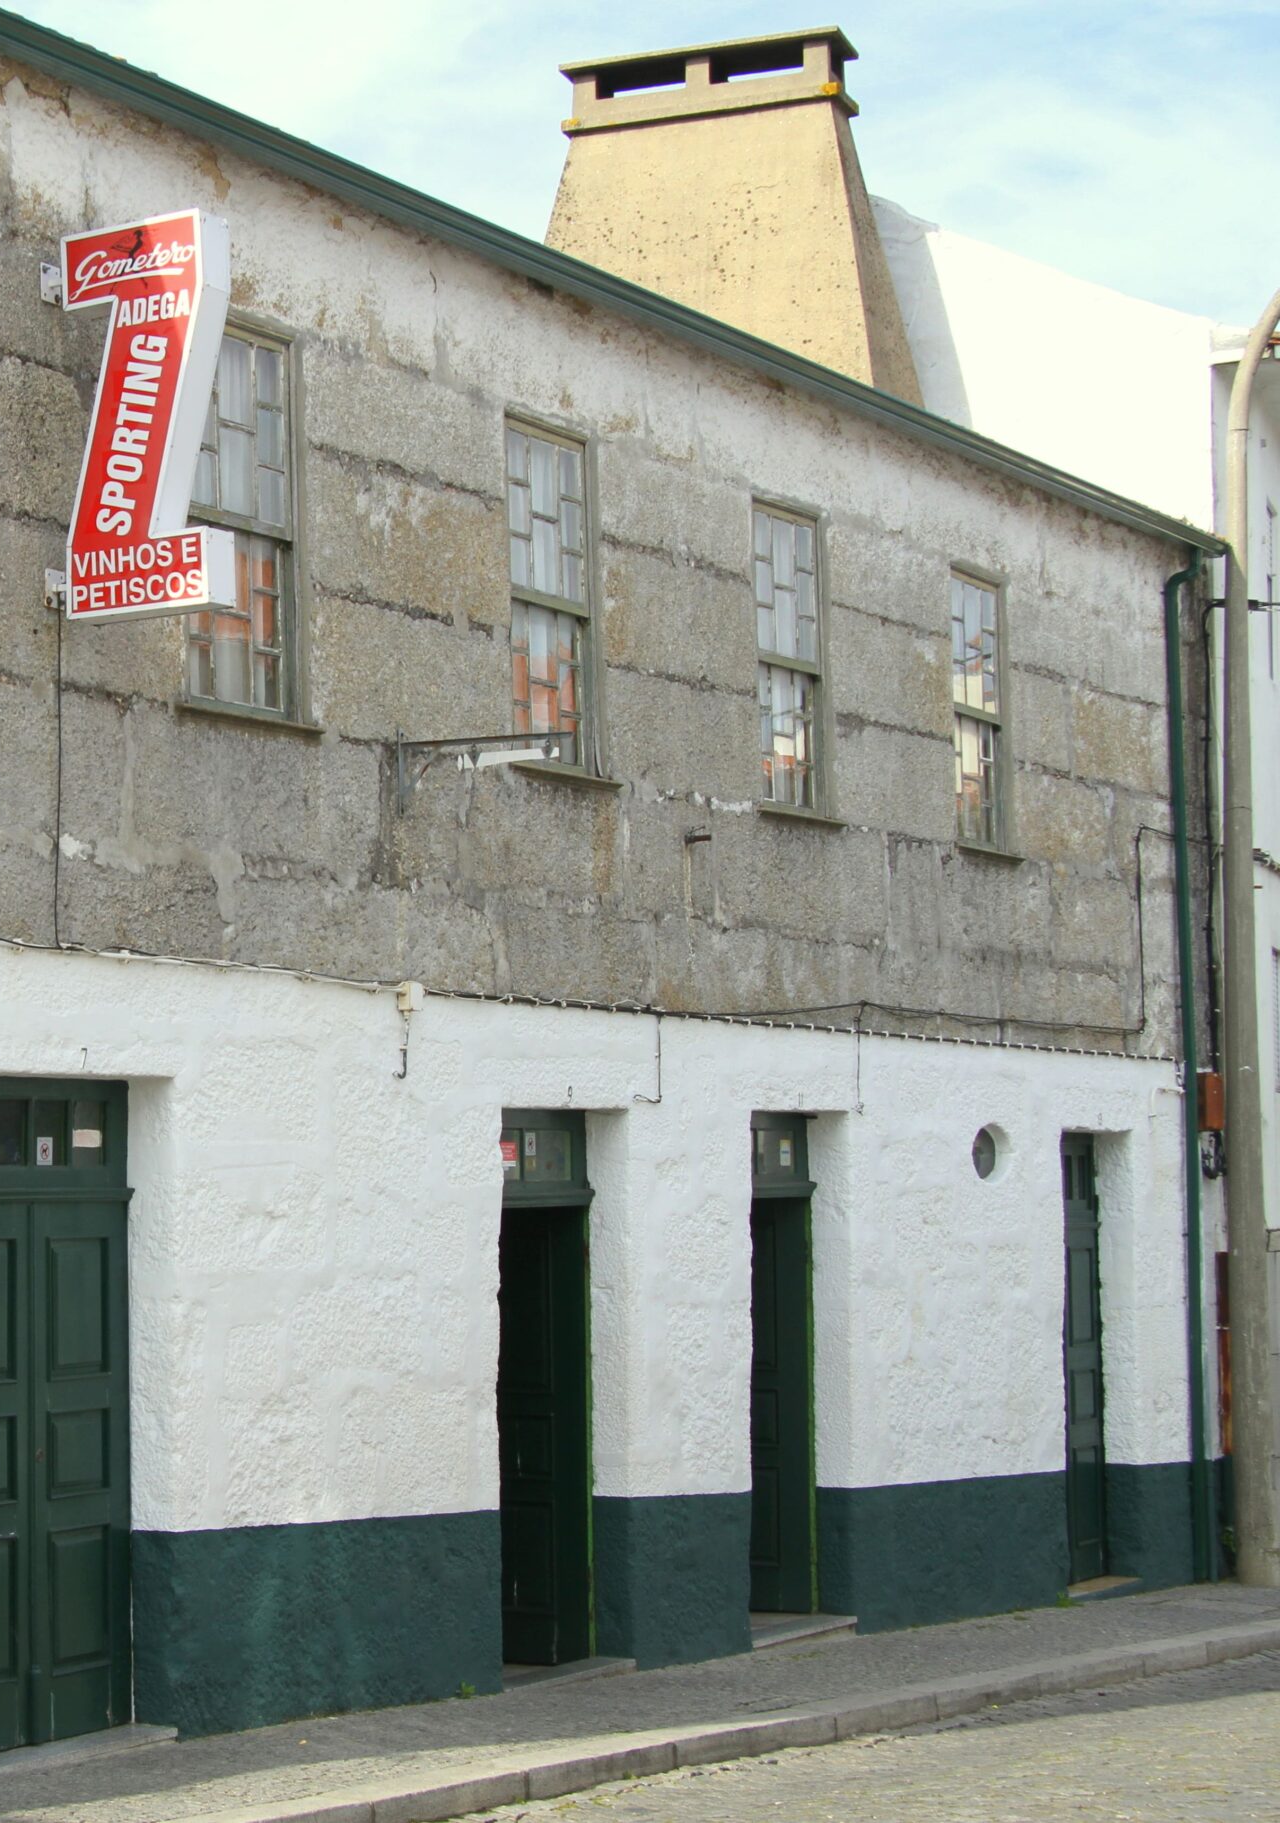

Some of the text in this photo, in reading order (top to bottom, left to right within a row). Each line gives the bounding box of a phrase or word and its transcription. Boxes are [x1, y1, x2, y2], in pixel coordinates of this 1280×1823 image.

[69, 241, 195, 301] Gometero
[117, 289, 190, 328] ADEGA
[95, 334, 169, 536] SPORTING
[73, 537, 198, 578] VINHOS E
[72, 569, 202, 611] PETISCOS
[81, 1047, 88, 1069] 7
